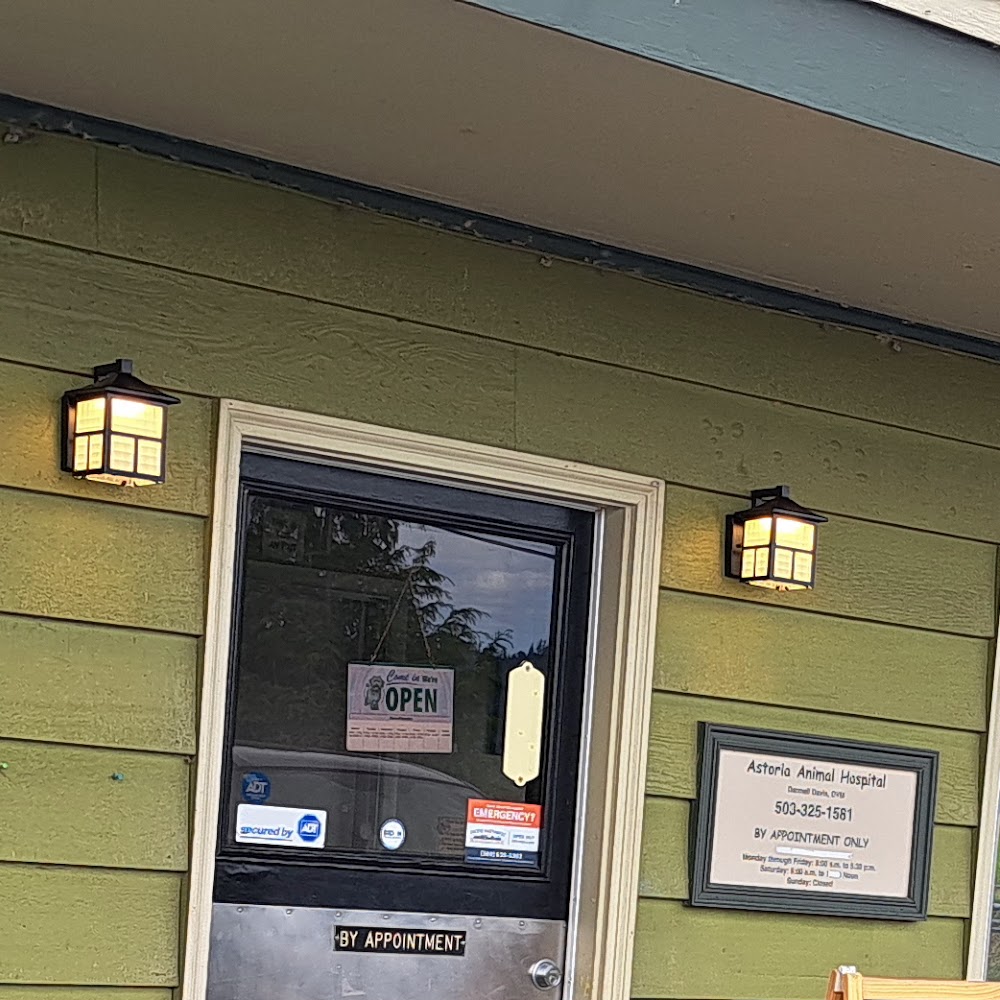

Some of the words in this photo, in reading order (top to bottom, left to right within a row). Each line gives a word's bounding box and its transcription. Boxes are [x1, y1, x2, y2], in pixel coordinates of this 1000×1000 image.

[385, 687, 438, 713] OPEN
[746, 760, 791, 778] Astoria
[797, 765, 835, 783] Animal
[840, 769, 887, 790] Hospital
[245, 781, 269, 794] ADT
[473, 807, 536, 823] EMERGENCY?
[240, 826, 280, 837] secured
[281, 826, 294, 839] by
[301, 820, 320, 835] ADT
[753, 827, 767, 839] BY
[769, 829, 841, 847] APPOINTMENT
[843, 836, 870, 848] ONLY
[786, 876, 812, 887] Sunday:
[812, 879, 834, 888] Closed
[339, 930, 358, 948] BY
[364, 931, 463, 951] APPOINTMENT
